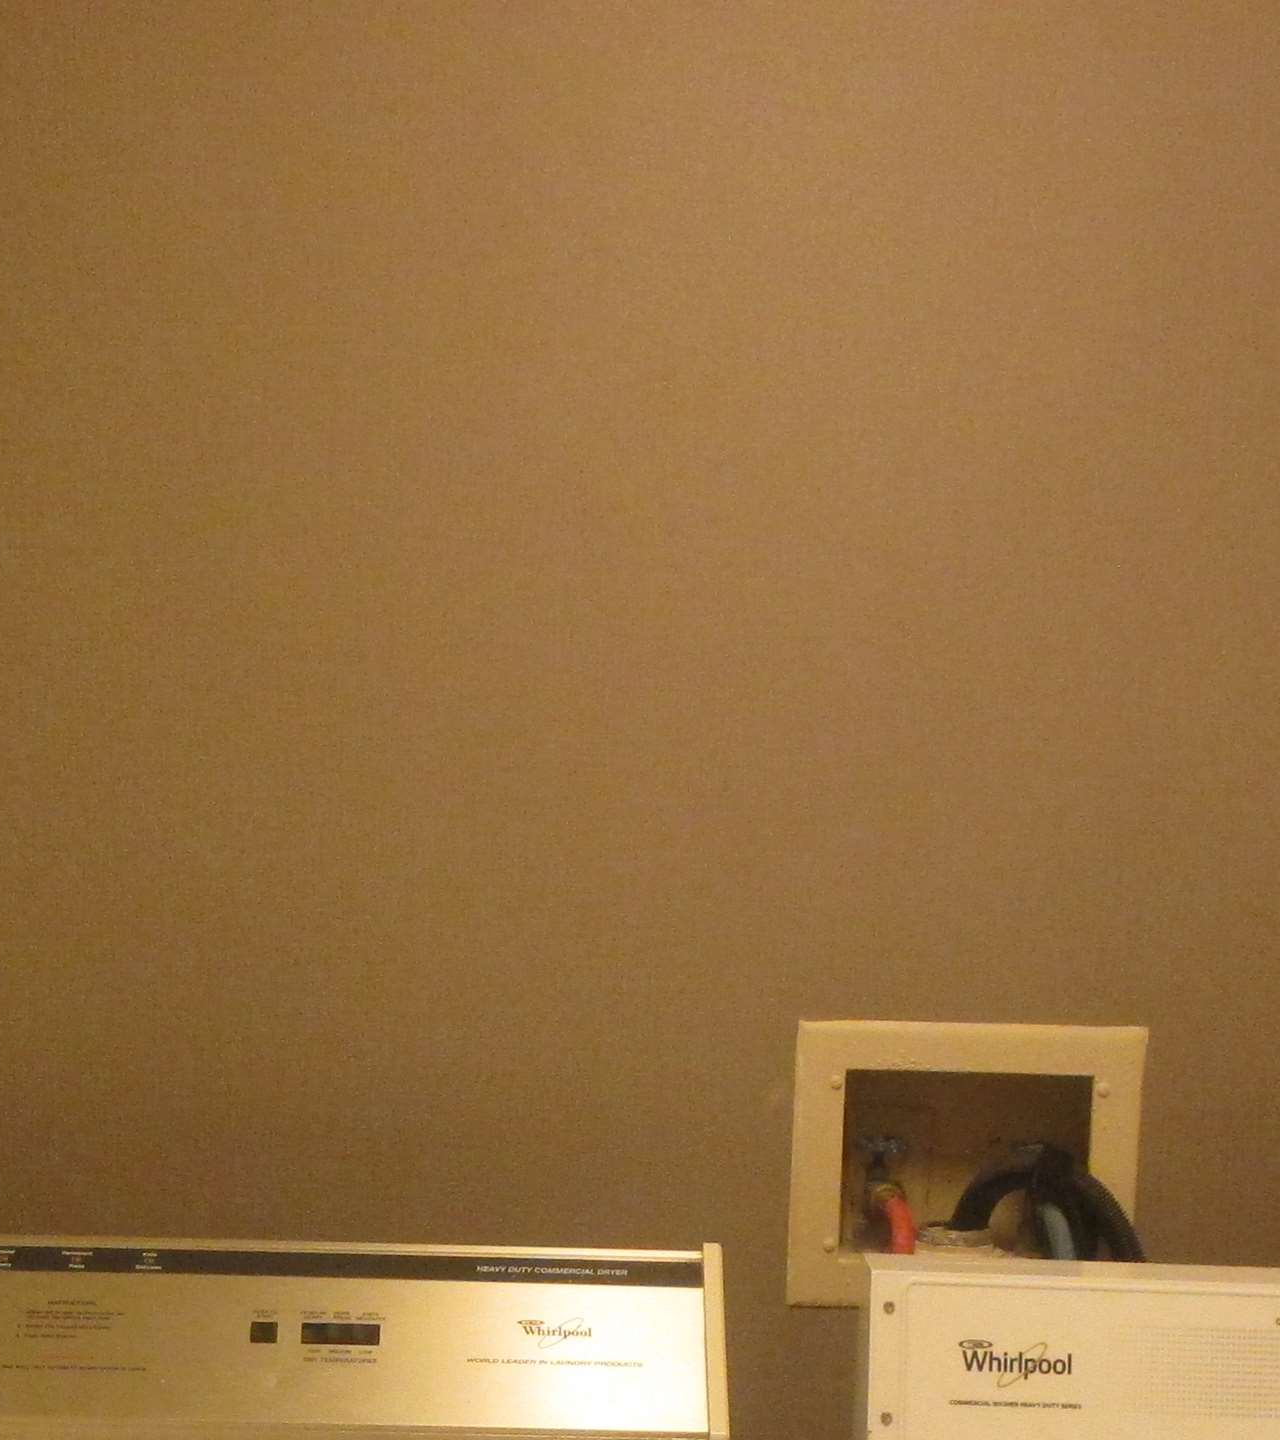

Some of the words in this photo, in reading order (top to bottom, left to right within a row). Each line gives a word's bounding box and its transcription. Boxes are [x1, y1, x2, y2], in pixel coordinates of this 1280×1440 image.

[476, 1265, 506, 1273] HEAVY
[507, 1266, 533, 1274] DUTY
[534, 1267, 594, 1275] COMMERCIAL
[521, 1325, 593, 1340] Whirlpool
[962, 1349, 1073, 1381] Whirlpool
